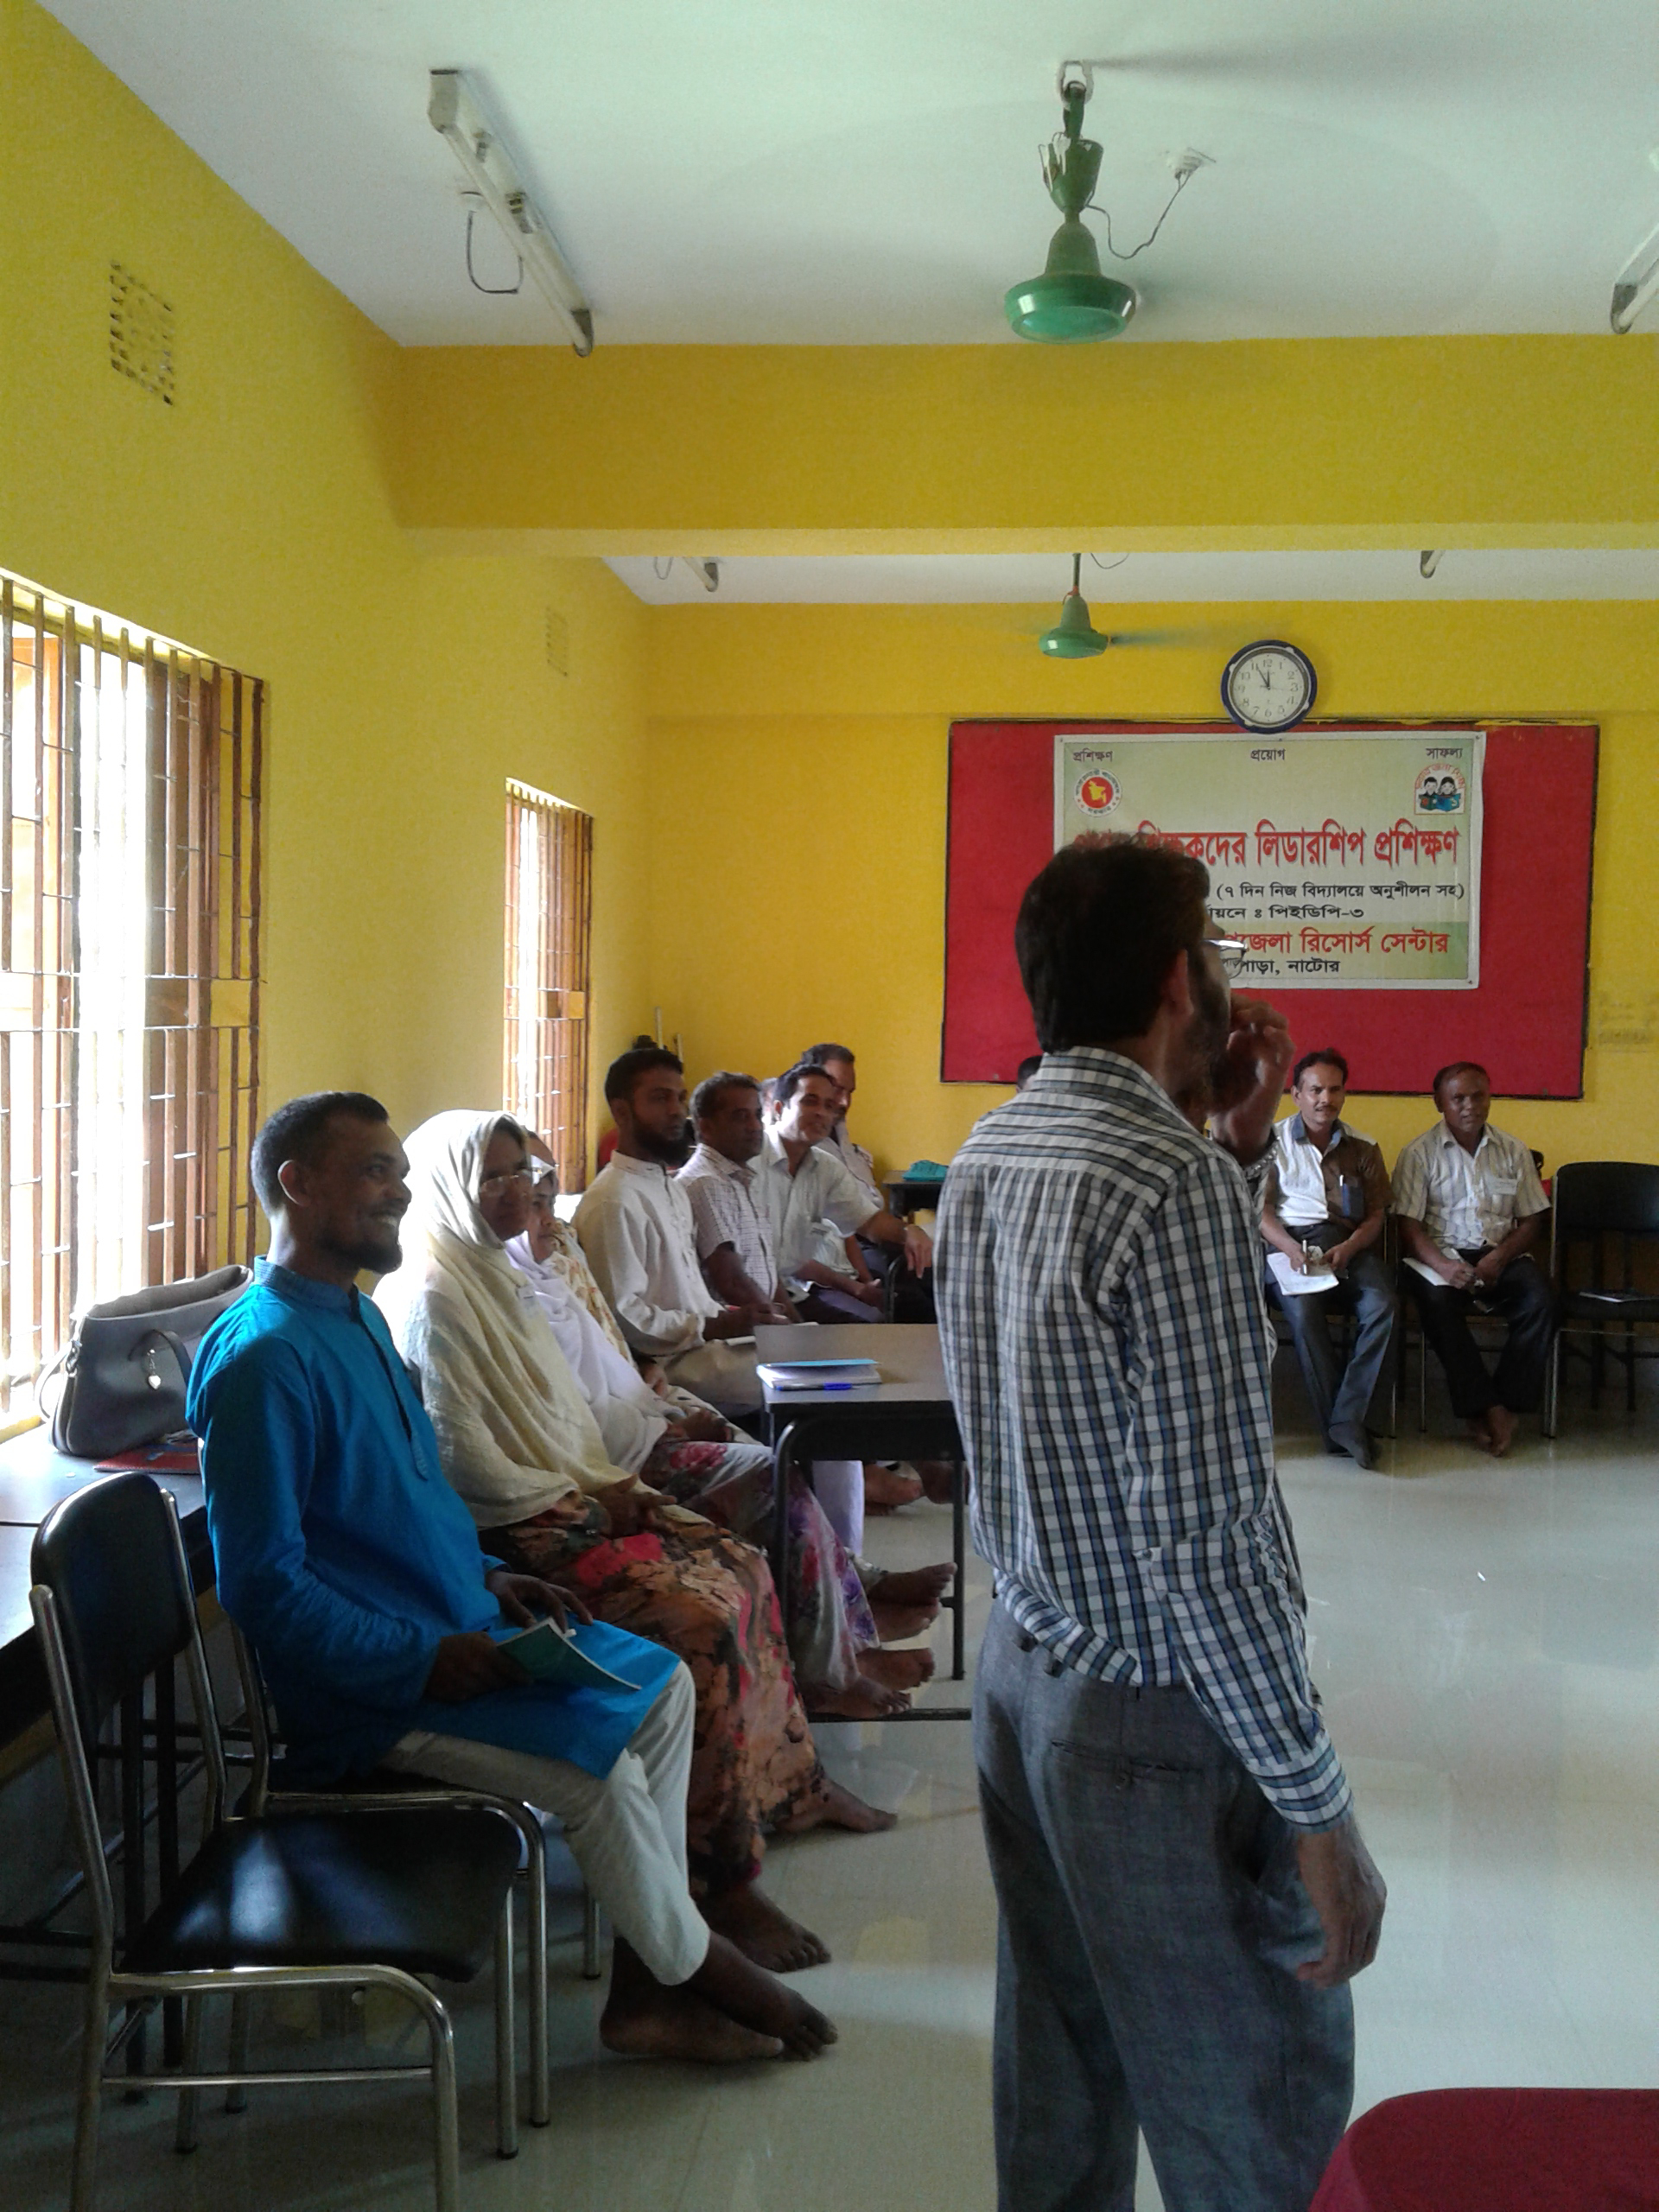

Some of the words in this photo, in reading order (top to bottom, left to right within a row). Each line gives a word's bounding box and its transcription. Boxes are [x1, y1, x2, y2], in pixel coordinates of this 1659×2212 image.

[1262, 658, 1273, 668] 12
[1072, 747, 1114, 762] প্রশিক্ষণ
[1250, 748, 1286, 761] প্রয়োগ
[1254, 818, 1366, 868] লিডারশিপ
[1374, 817, 1460, 869] প্রশিক্ষণ
[1240, 881, 1264, 898] দিন
[1270, 881, 1297, 898] নিজ
[1303, 881, 1364, 898] বিদ্যালয়ে
[1370, 880, 1430, 899] অনুশীলন
[1269, 905, 1364, 919] পিইডিপি-৩
[1300, 925, 1375, 954] রিসোর্স
[1381, 926, 1450, 954] সেন্টার
[1287, 957, 1340, 974] নাটোর
